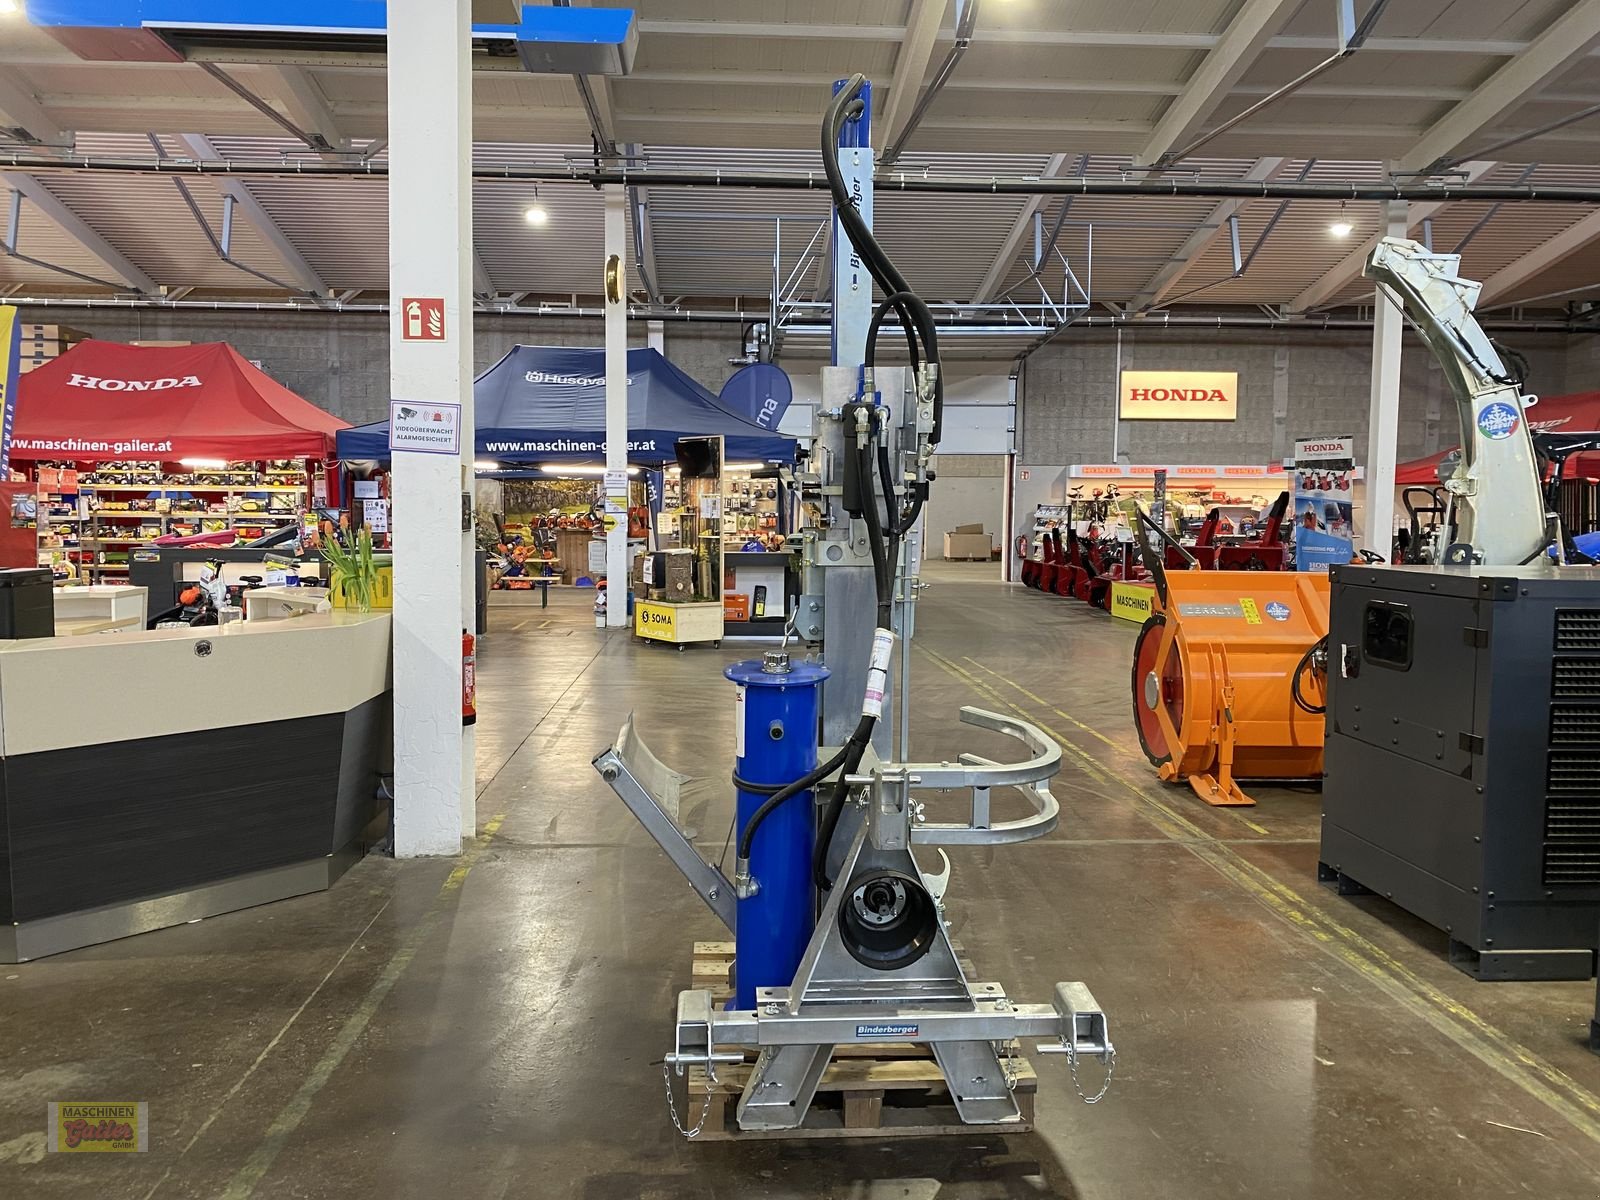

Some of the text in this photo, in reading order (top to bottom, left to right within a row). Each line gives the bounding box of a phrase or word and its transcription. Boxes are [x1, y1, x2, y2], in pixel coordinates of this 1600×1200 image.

[66, 373, 203, 392] HONDA
[544, 374, 632, 386] Husqvaa
[1130, 388, 1228, 402] HONDA
[756, 398, 778, 427] rna
[395, 425, 453, 435] VIDEOÜBERWACHT
[396, 434, 452, 443] ALARMGESICHERT
[10, 438, 172, 454] ww.maschinen-gailer.at
[486, 439, 656, 454] www.maschinen-ger.at
[1303, 443, 1344, 452] HONDA
[1116, 594, 1150, 612] MASCHINEN
[651, 613, 672, 625] SOMA
[857, 1025, 917, 1034] Binderberger
